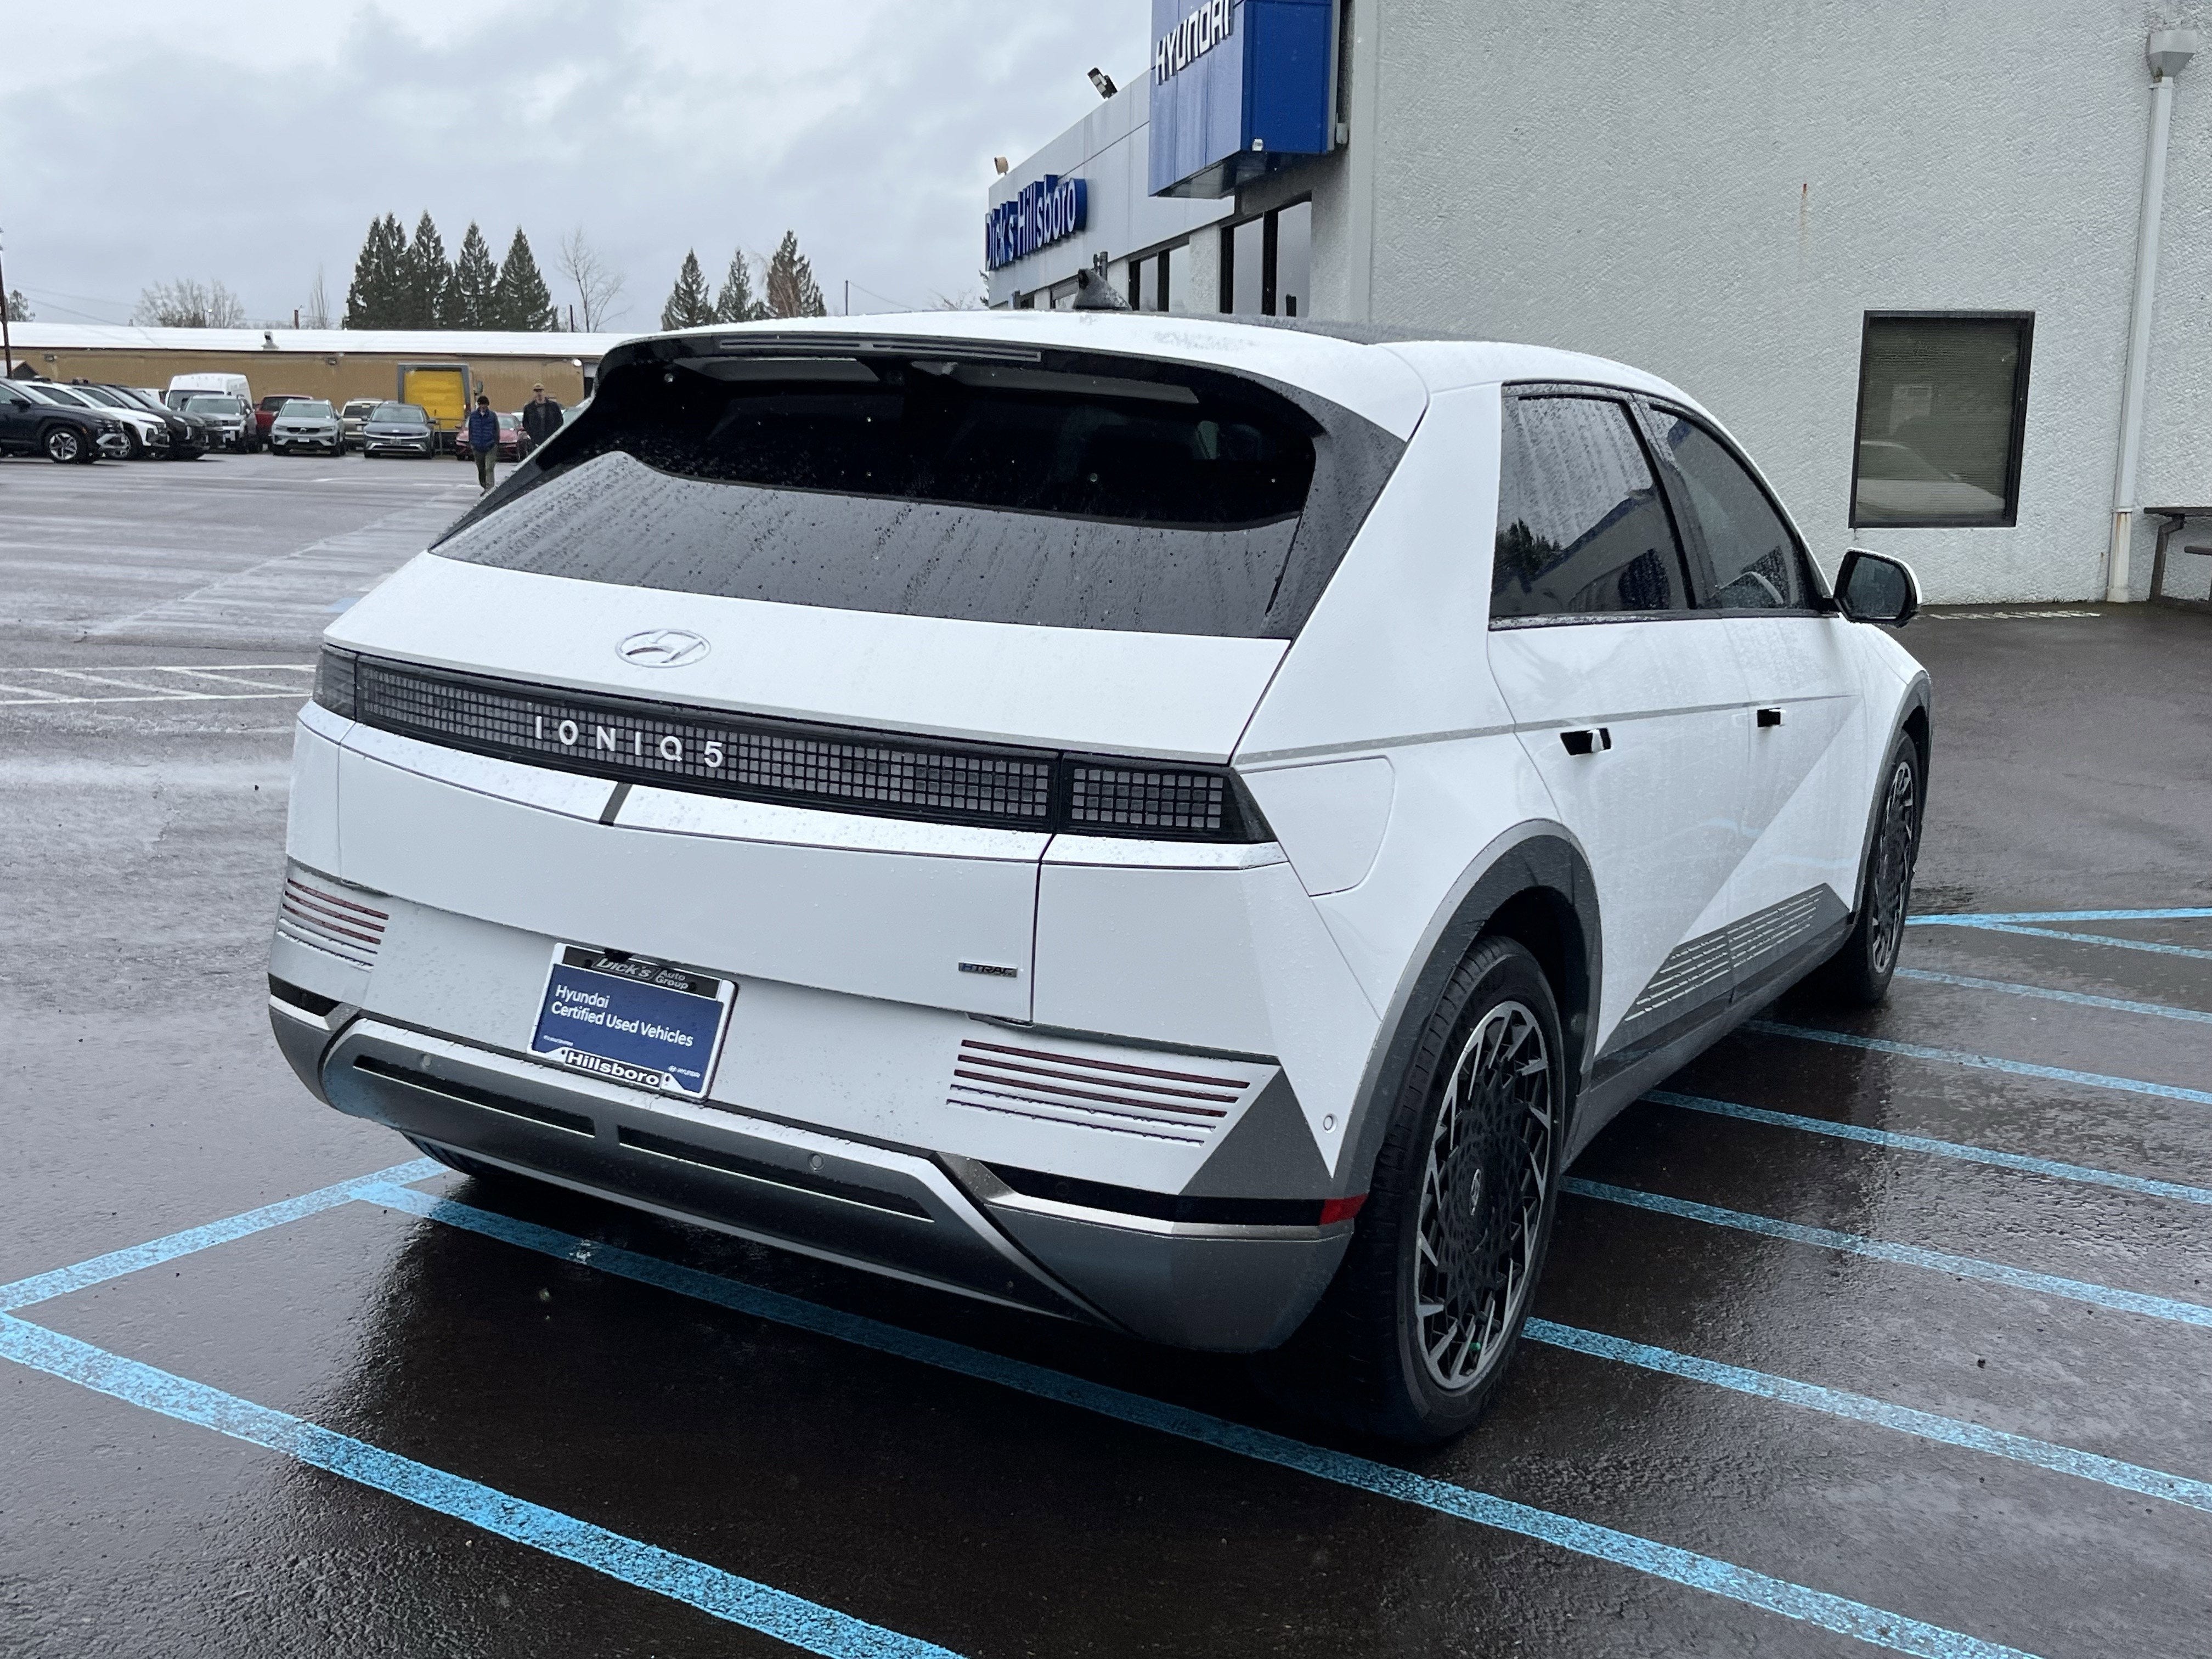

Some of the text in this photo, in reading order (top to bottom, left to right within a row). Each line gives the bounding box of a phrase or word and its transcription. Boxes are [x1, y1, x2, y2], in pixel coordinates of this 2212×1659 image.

[1155, 0, 1229, 86] HYUNDAI
[985, 174, 1076, 272] Dick's Hillsboro
[535, 715, 723, 768] IONIQ 5
[655, 975, 689, 989] Group
[659, 969, 686, 981] Auto
[555, 984, 611, 1008] Hyundai
[551, 1001, 694, 1047] Certified Used Vehicles
[567, 1051, 660, 1085] Hillsboro
